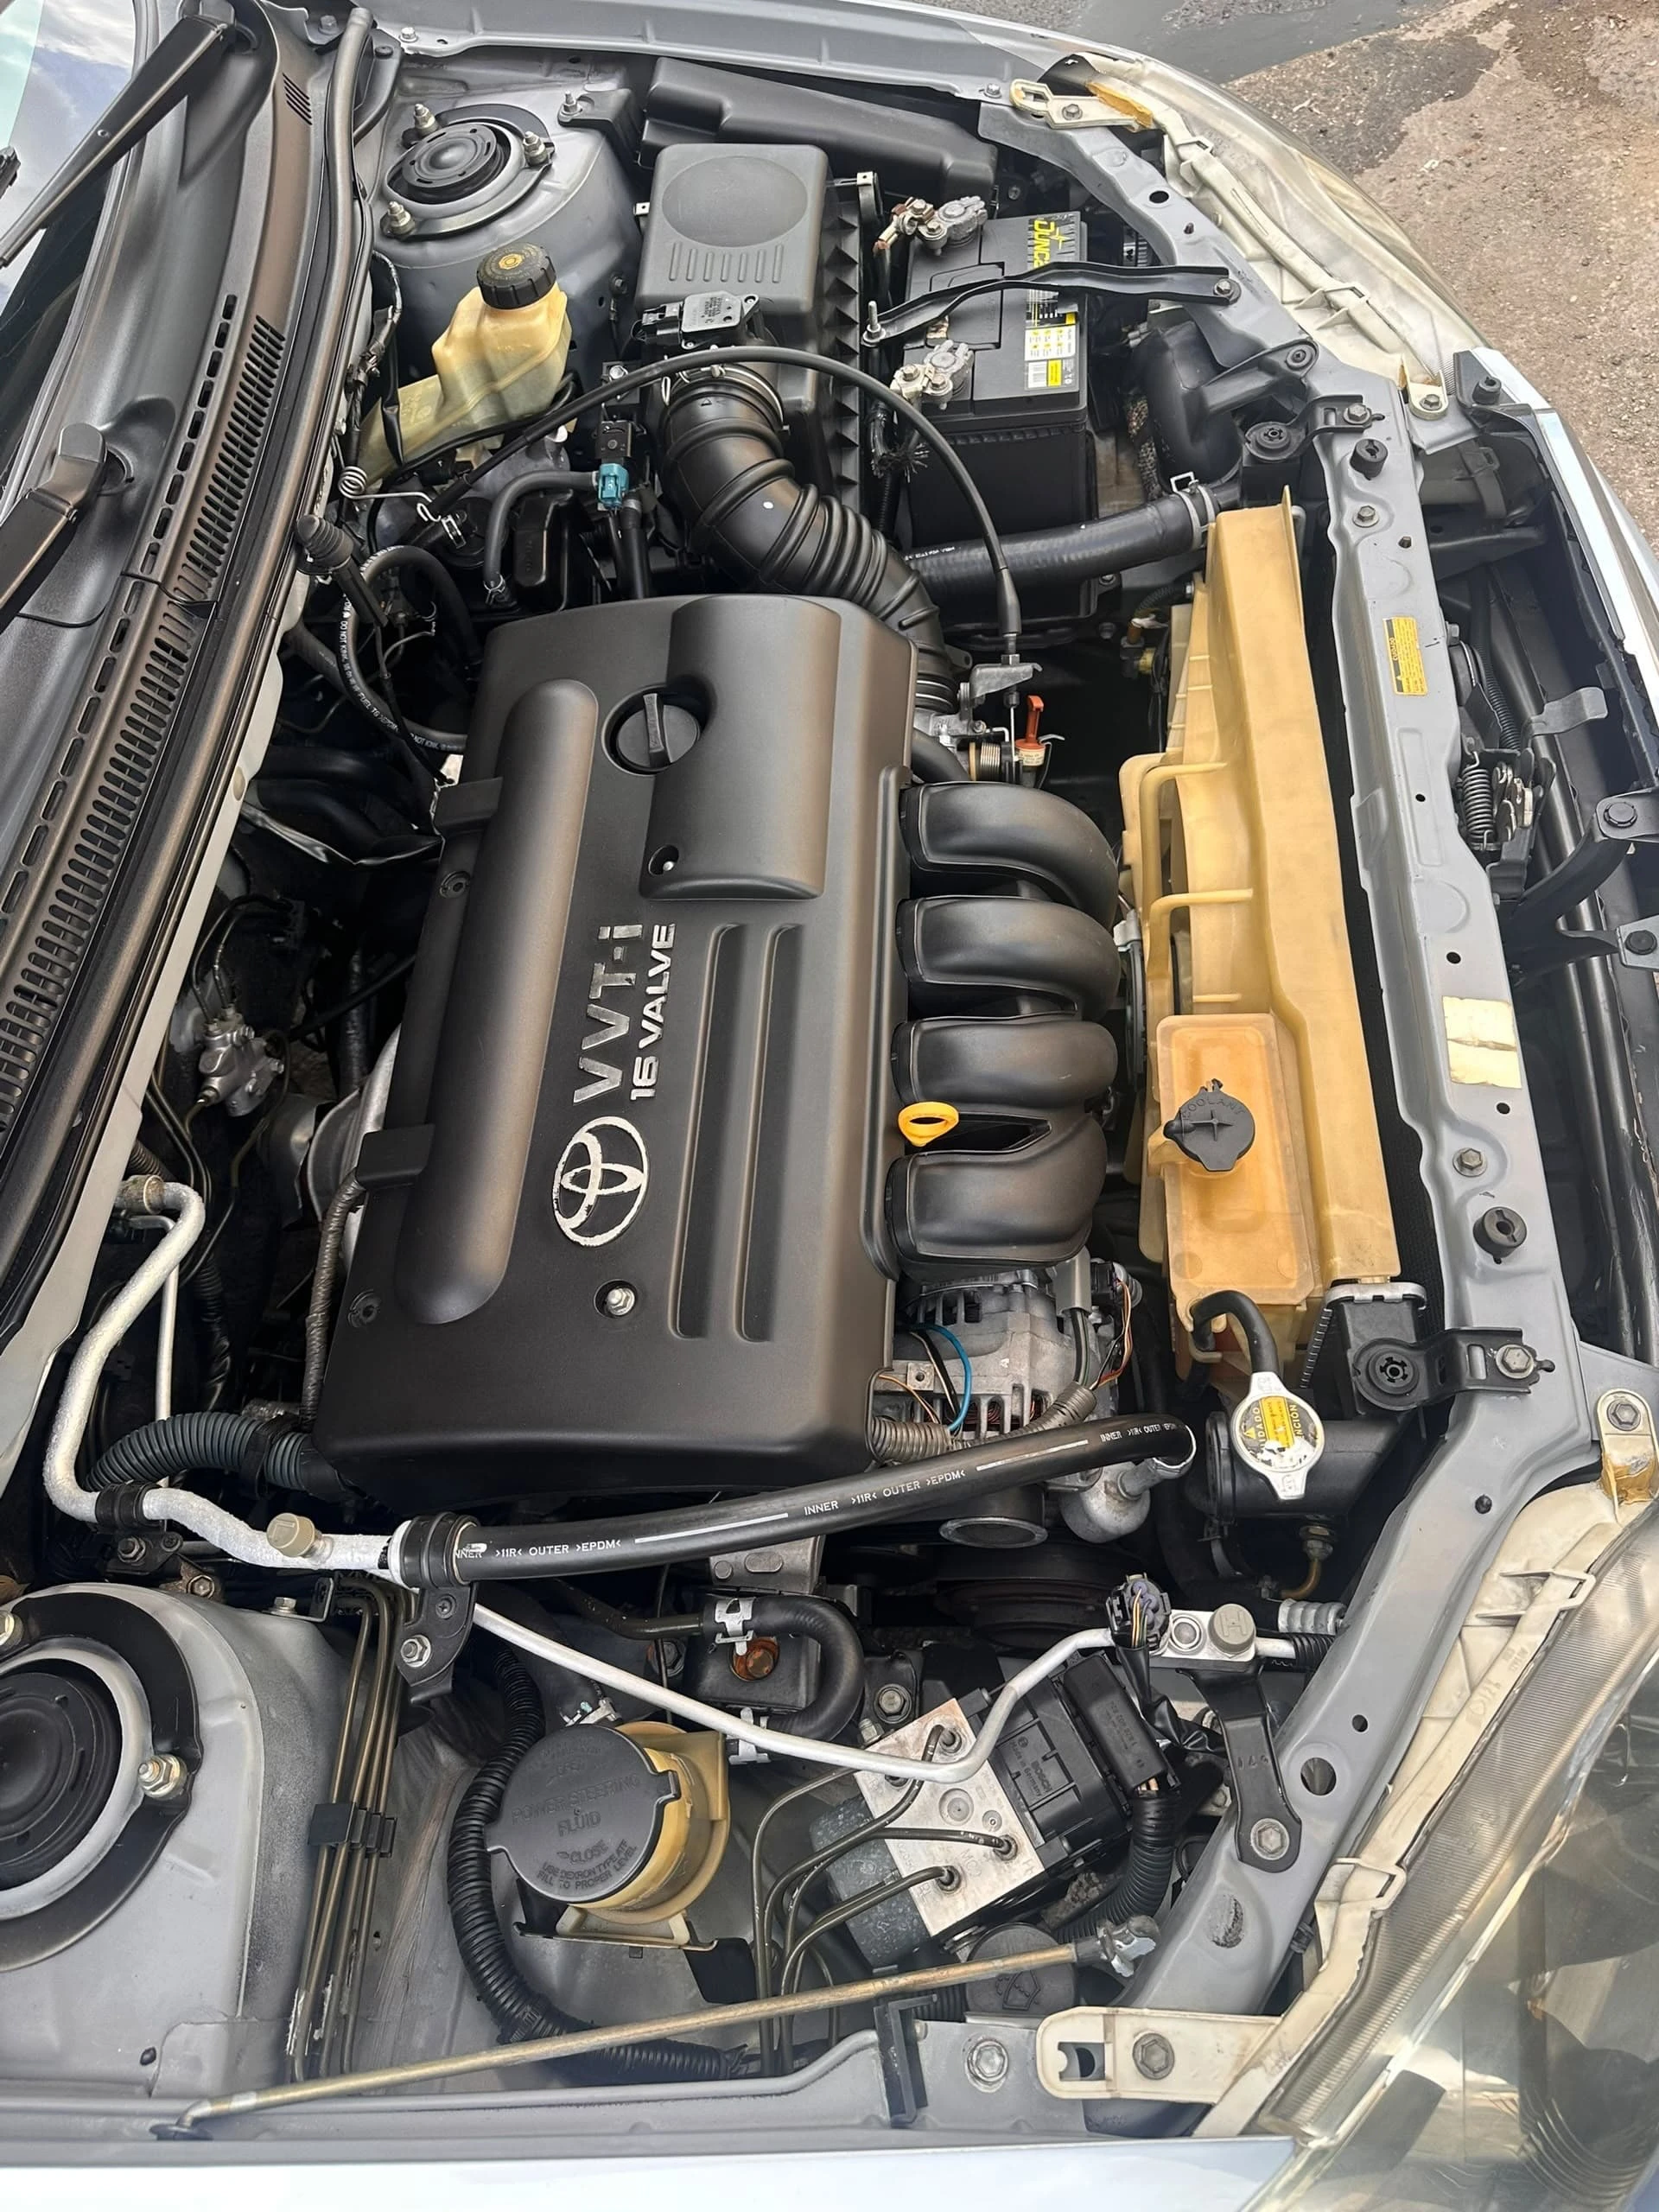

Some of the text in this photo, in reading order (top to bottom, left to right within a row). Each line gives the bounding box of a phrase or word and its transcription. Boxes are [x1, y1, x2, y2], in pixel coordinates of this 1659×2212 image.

[358, 691, 372, 710] FUEL
[630, 923, 676, 1101] 16 VALVE
[1182, 1098, 1246, 1120] COOLANT
[804, 1500, 839, 1516] INNER
[882, 1480, 921, 1497] OUTER
[528, 1544, 569, 1556] OUTER
[512, 1774, 639, 1824] POWER STEERING
[557, 1812, 601, 1836] FLUID
[570, 1840, 608, 1864] CLOSE
[537, 1871, 554, 1886] FILL
[575, 1872, 613, 1889] PROPER
[614, 1847, 637, 1871] LEVEL
